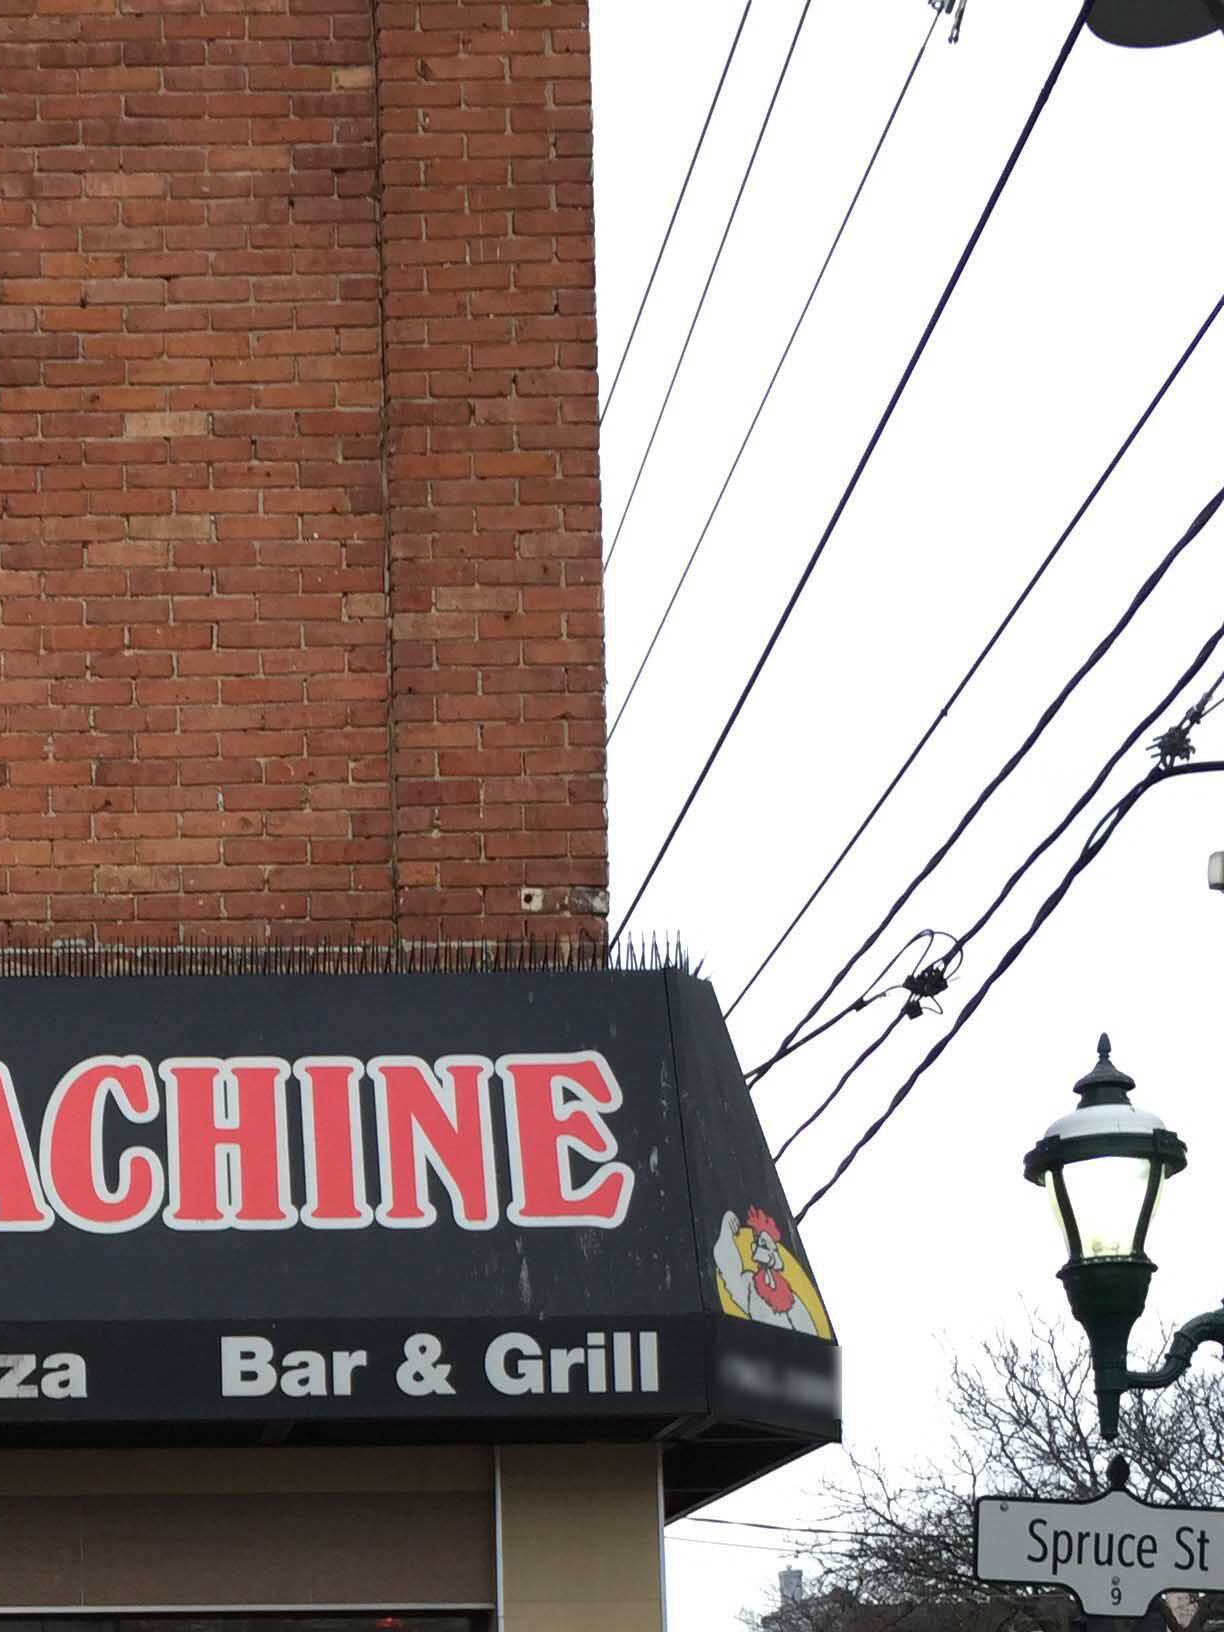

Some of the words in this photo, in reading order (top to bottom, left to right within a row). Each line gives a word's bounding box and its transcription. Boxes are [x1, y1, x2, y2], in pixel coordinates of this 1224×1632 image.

[220, 1335, 368, 1398] Bar
[395, 1332, 457, 1396] &
[483, 1330, 660, 1394] Grill
[1027, 1518, 1158, 1575] Spruce
[1174, 1526, 1210, 1572] St
[1111, 1587, 1122, 1606] 9
